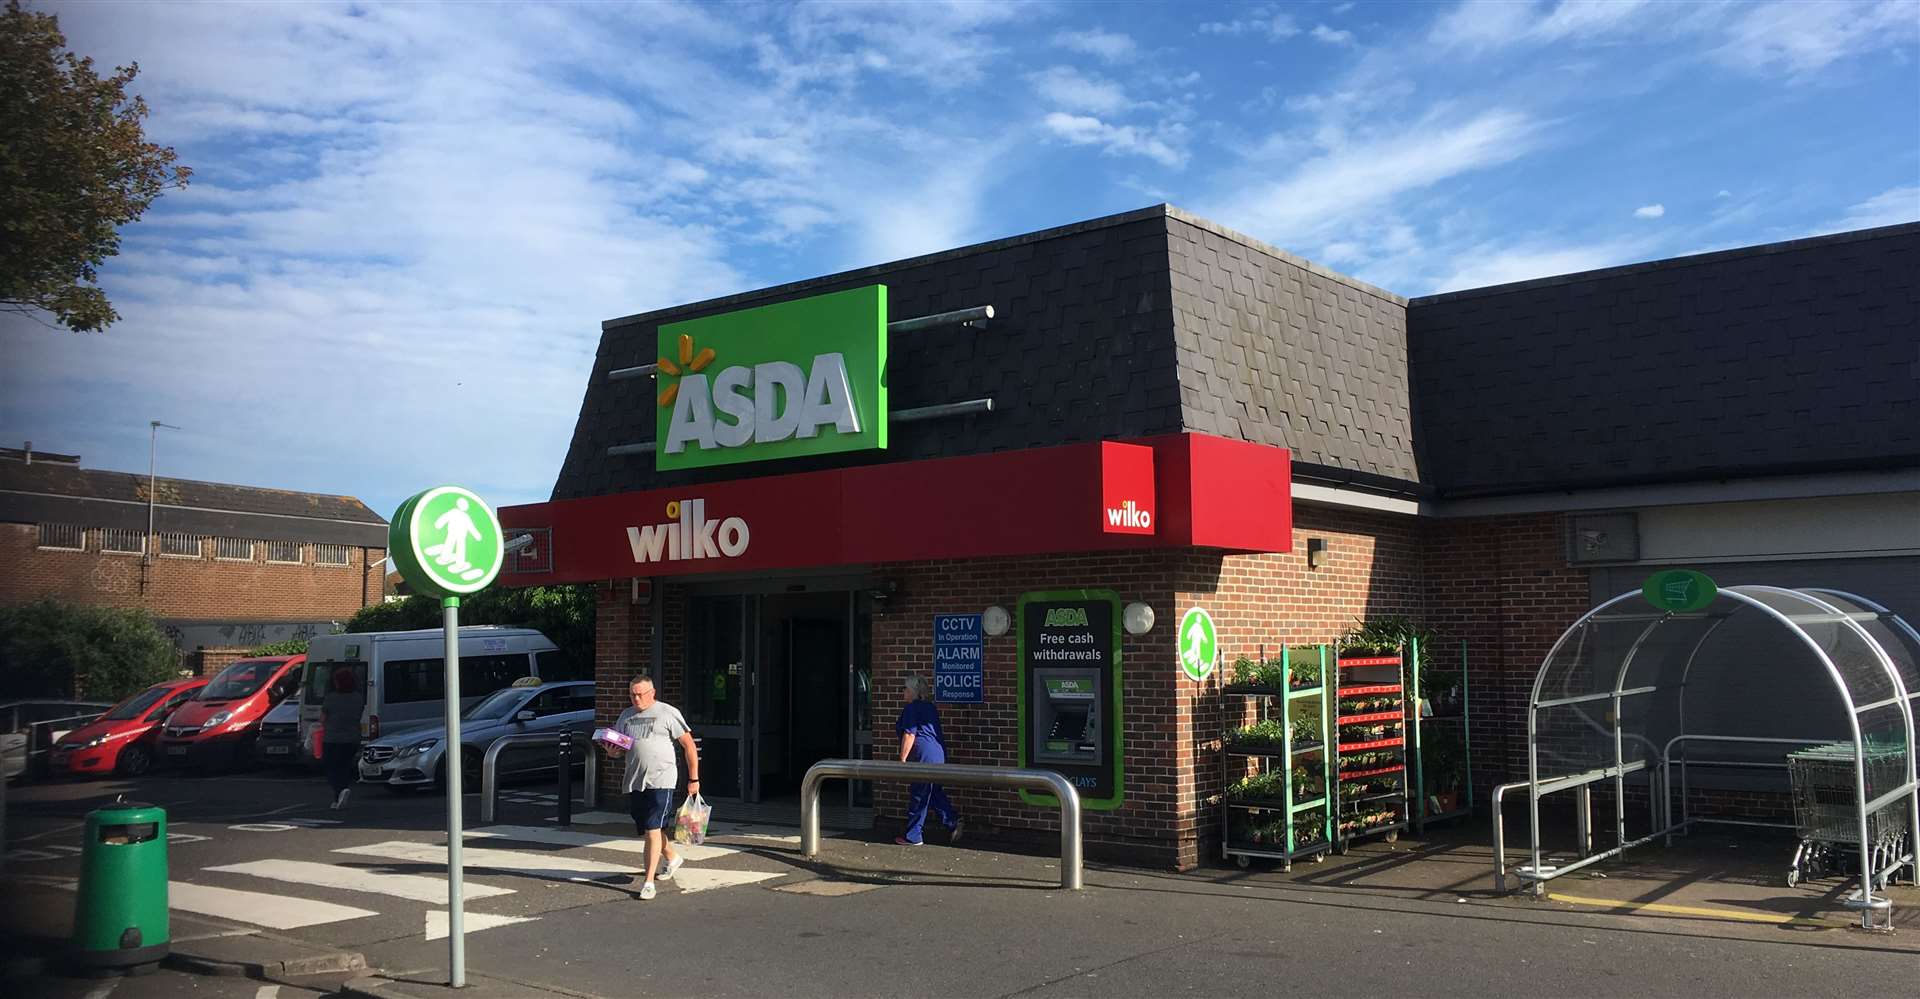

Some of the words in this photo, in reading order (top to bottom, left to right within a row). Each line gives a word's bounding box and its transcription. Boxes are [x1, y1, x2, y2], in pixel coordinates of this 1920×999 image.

[664, 352, 862, 454] ASDA
[1107, 500, 1151, 528] wilko
[626, 498, 750, 563] wilko
[1044, 607, 1089, 627] ASDA
[941, 618, 975, 631] CCTV
[938, 633, 945, 641] In
[945, 633, 978, 642] Operation
[1040, 633, 1065, 644] Free
[1068, 632, 1094, 644] cash
[936, 647, 980, 660] ALARM
[1033, 648, 1102, 660] withdrawals
[942, 662, 975, 670] Monitored
[936, 675, 981, 688] POLICE
[1061, 681, 1079, 689] ASDA
[942, 690, 975, 698] Response
